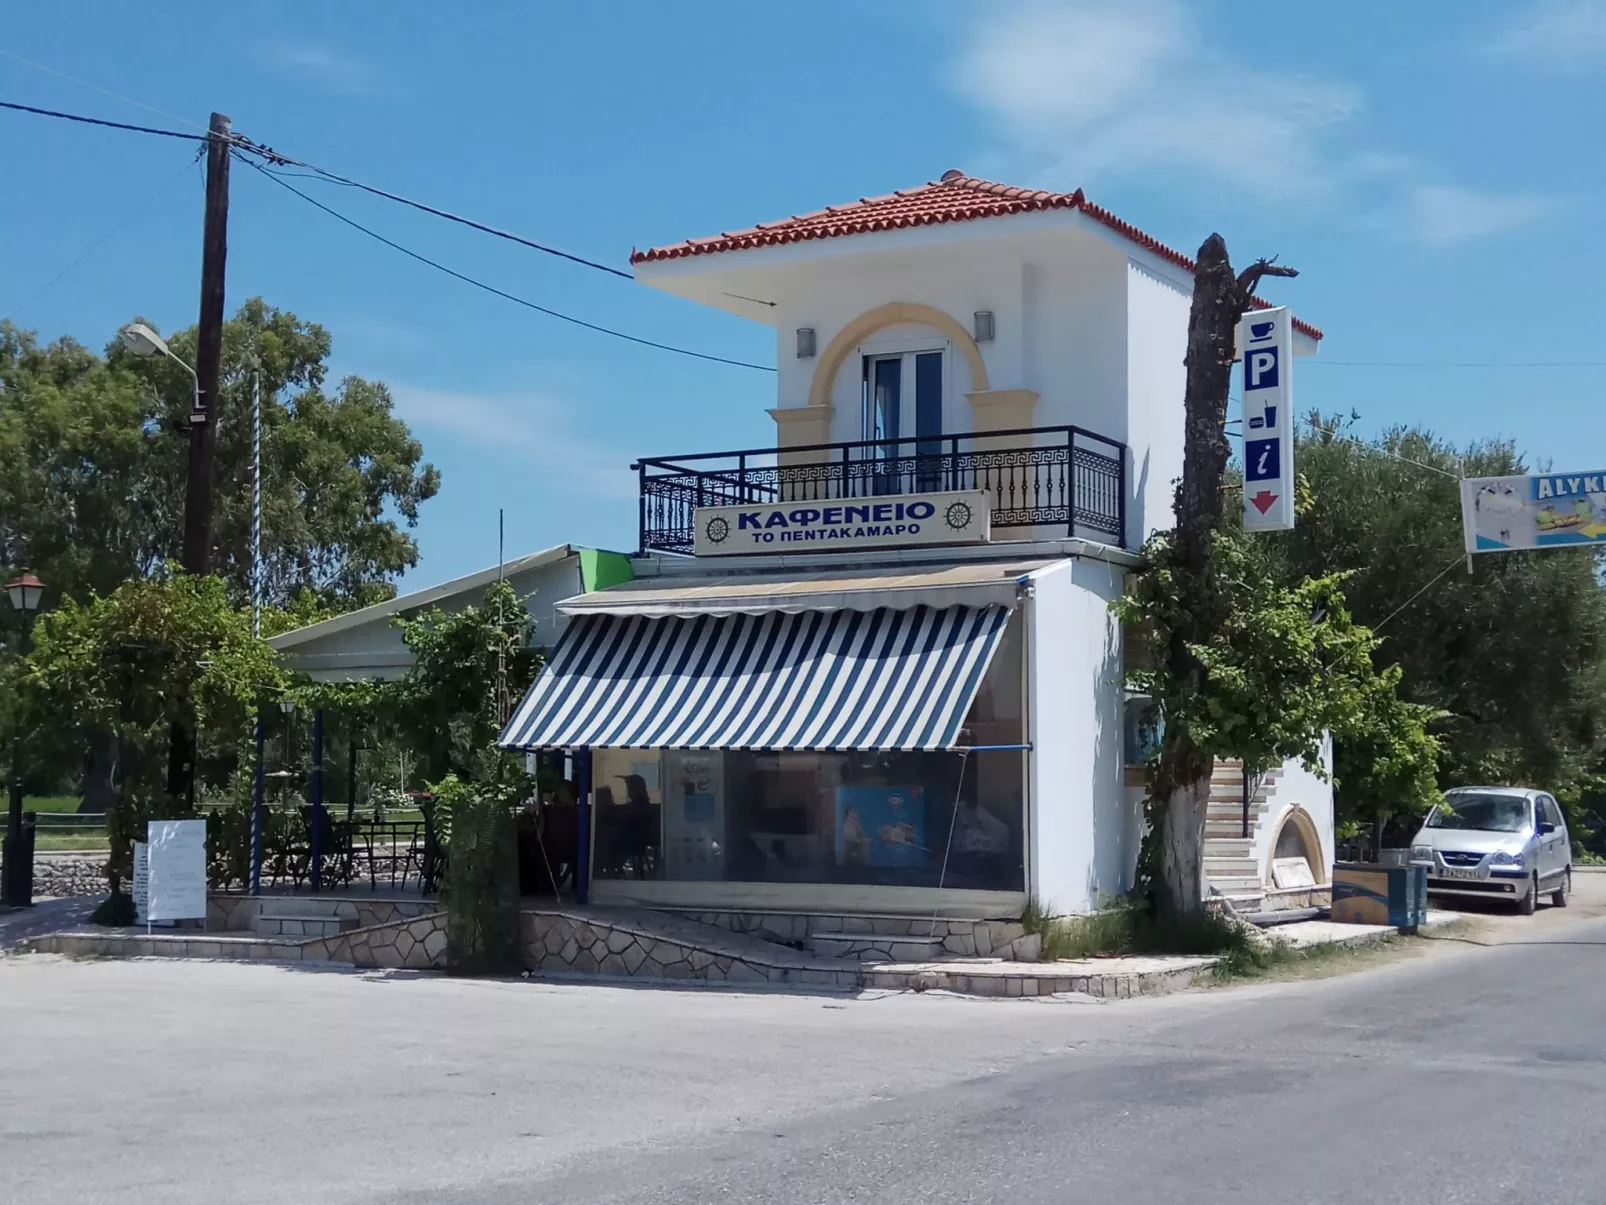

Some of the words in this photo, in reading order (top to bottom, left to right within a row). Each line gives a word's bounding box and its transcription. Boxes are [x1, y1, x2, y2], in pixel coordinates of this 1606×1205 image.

[1251, 352, 1275, 386] P
[1257, 444, 1271, 475] i
[738, 501, 935, 530] ΚΑΦΕΝΕΙΟ
[752, 532, 774, 543] ΤΟ
[781, 523, 920, 542] ΠΕΝΤΑΚΑΜΑΡΟ
